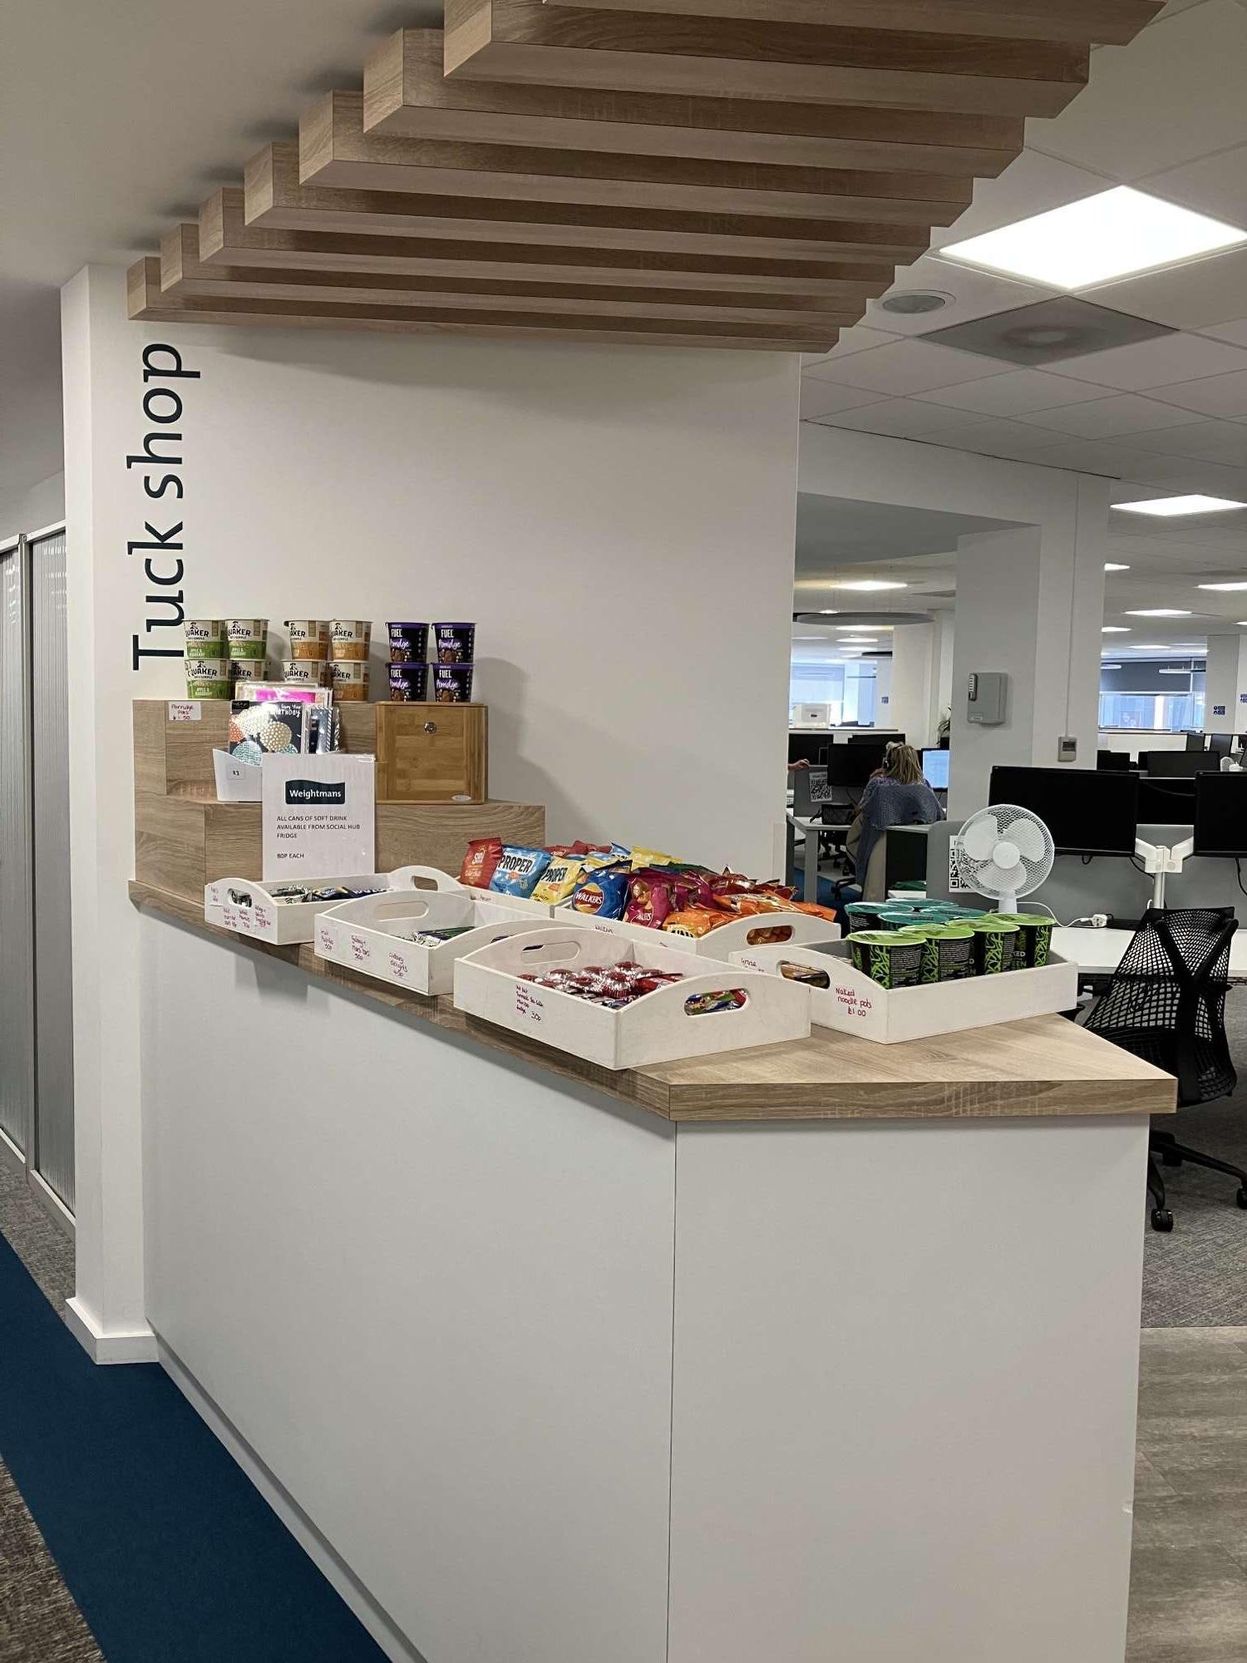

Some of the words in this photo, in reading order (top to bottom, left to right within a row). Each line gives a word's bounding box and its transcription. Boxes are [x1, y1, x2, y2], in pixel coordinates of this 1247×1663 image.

[126, 342, 201, 499] shop
[127, 521, 185, 671] Tuck
[391, 628, 403, 638] FUEL
[441, 628, 454, 638] FUEL
[390, 669, 402, 678] FUEL
[439, 669, 452, 678] FUEL
[289, 789, 341, 799] Weightmans
[498, 854, 533, 873] PROPER
[835, 987, 855, 997] Naked
[837, 996, 857, 1006] noodle
[860, 998, 872, 1008] pots
